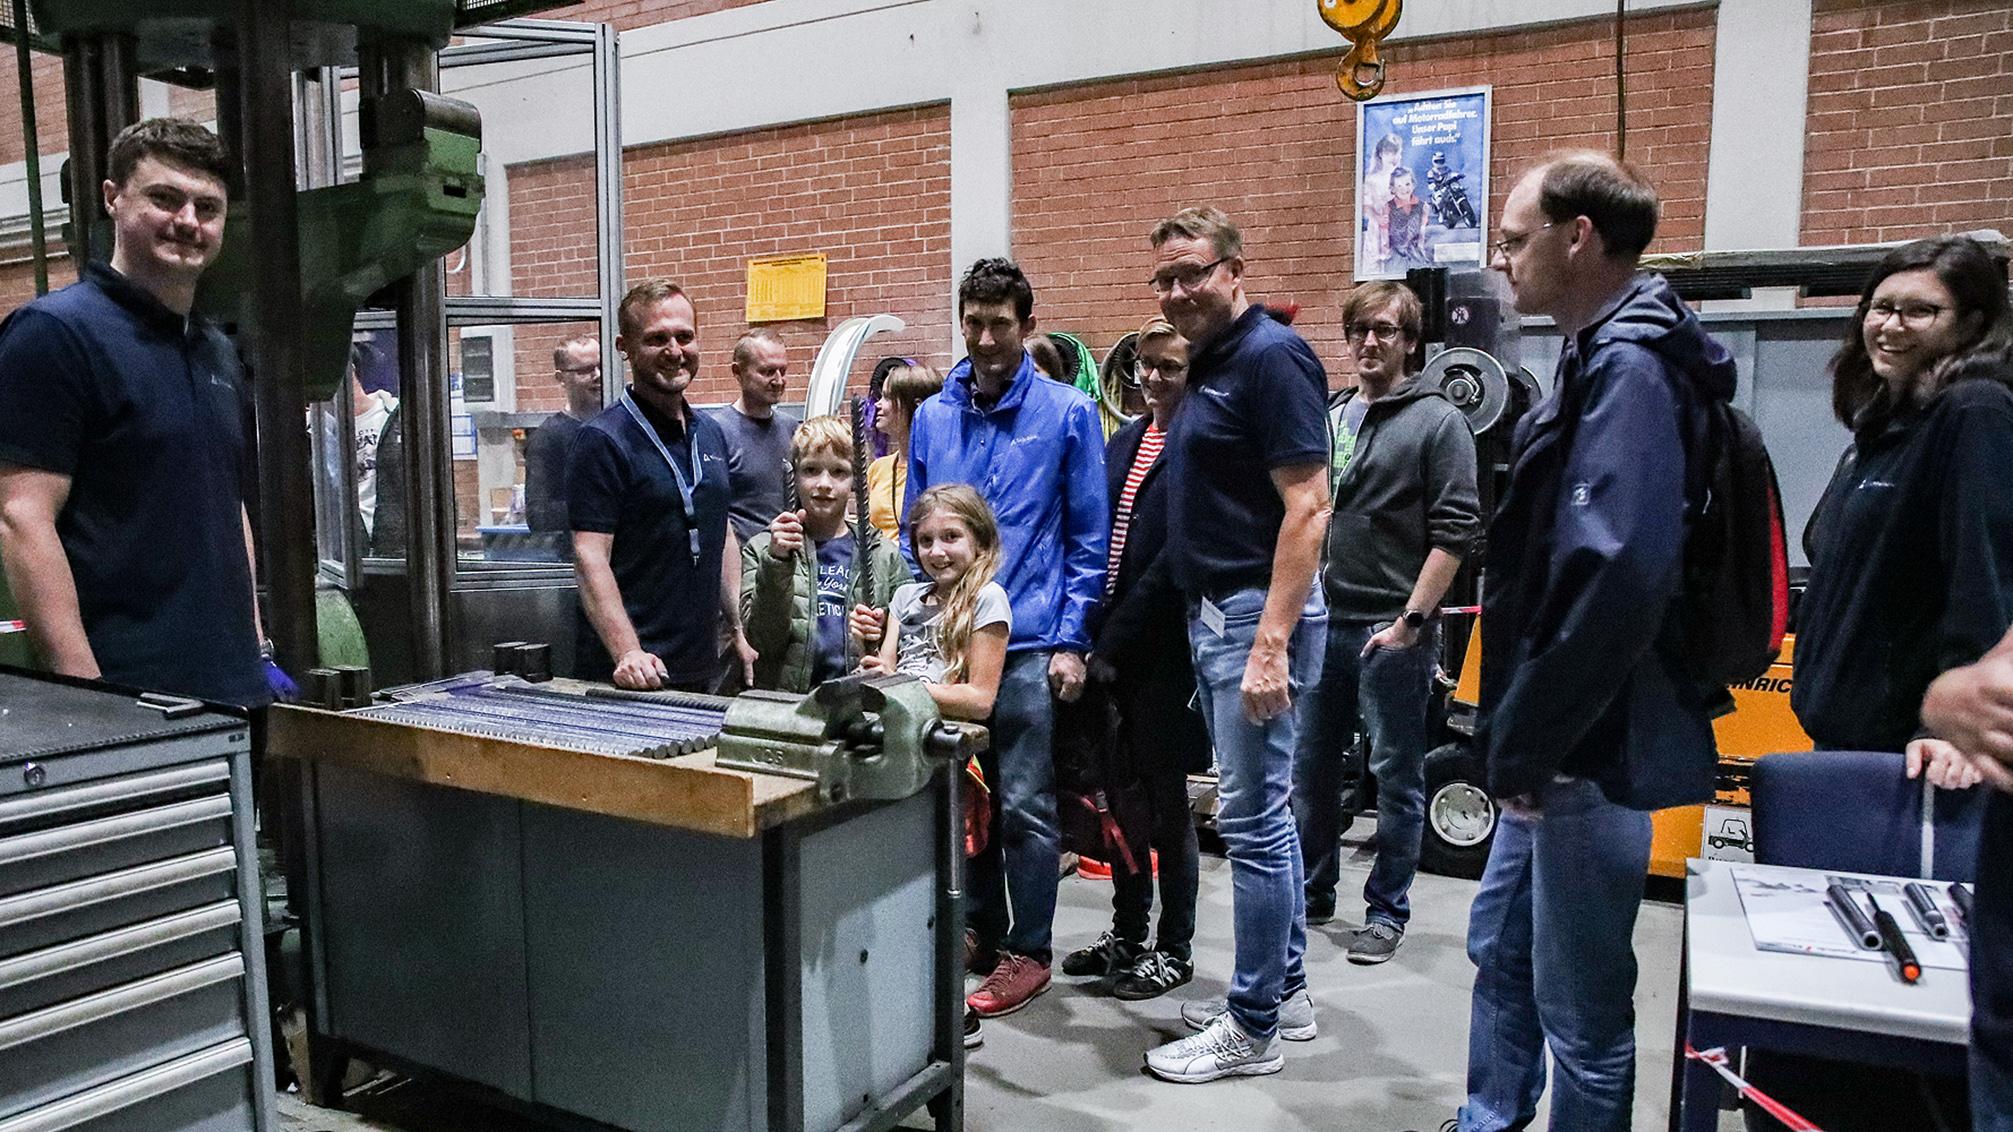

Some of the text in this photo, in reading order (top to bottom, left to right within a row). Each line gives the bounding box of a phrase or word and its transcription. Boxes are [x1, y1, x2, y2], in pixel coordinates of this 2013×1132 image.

[1393, 114, 1408, 125] auf
[1412, 120, 1457, 134] Unser Papi
[1412, 134, 1434, 147] fährt
[817, 601, 845, 617] ETIC
[1727, 678, 1792, 694] NRIC
